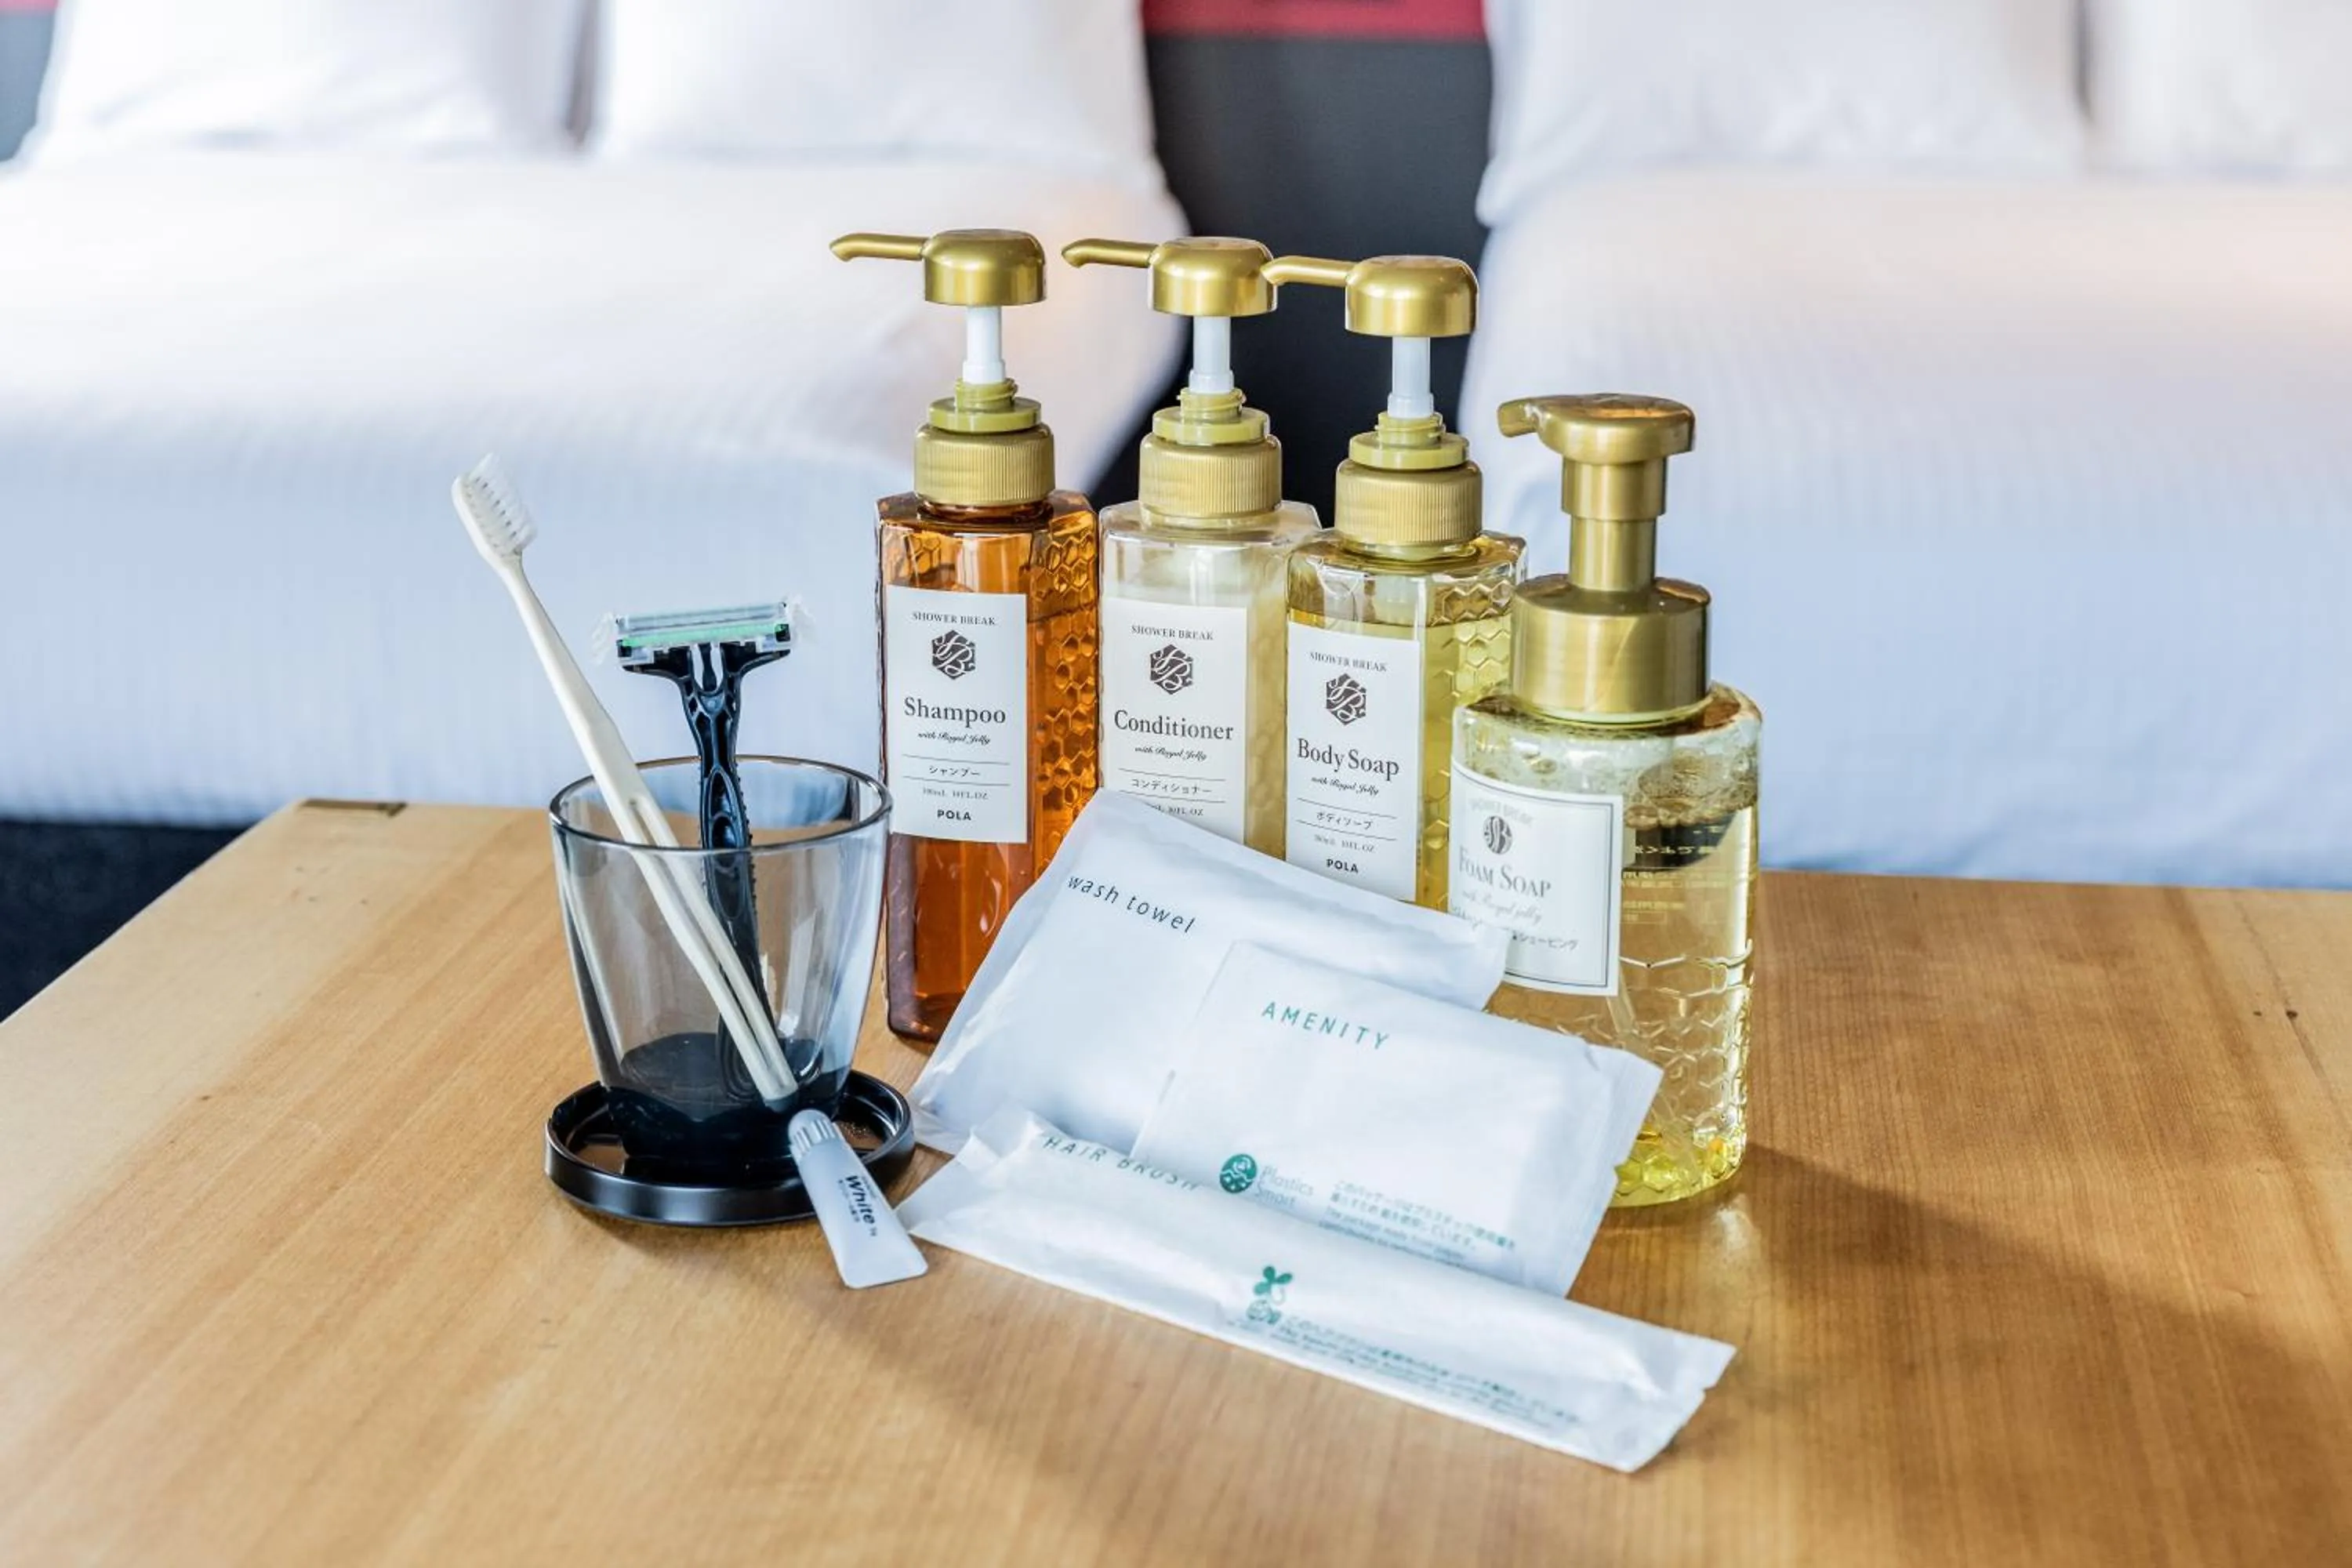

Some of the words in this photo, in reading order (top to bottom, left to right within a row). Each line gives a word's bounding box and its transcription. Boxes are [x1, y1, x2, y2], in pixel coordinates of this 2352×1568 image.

[913, 612, 957, 624] SHOWER
[960, 615, 996, 626] BREAK
[1131, 624, 1175, 638] SHOWER
[1178, 629, 1214, 641] BREAK
[1310, 651, 1349, 667] SHOWER
[1352, 659, 1387, 673] BREAK
[904, 696, 1007, 728] Shampoo
[1114, 710, 1235, 740] Conditioner
[1298, 738, 1345, 772] Body
[1348, 749, 1400, 781] Soap
[1132, 778, 1212, 795] コンディショナー
[937, 808, 972, 821] POLA
[1327, 858, 1359, 873] POLA
[1067, 875, 1120, 904] wash
[1127, 895, 1196, 934] towel
[1261, 1001, 1390, 1050] AMENITY
[1044, 1136, 1105, 1163] HAIR
[845, 1174, 876, 1225] White
